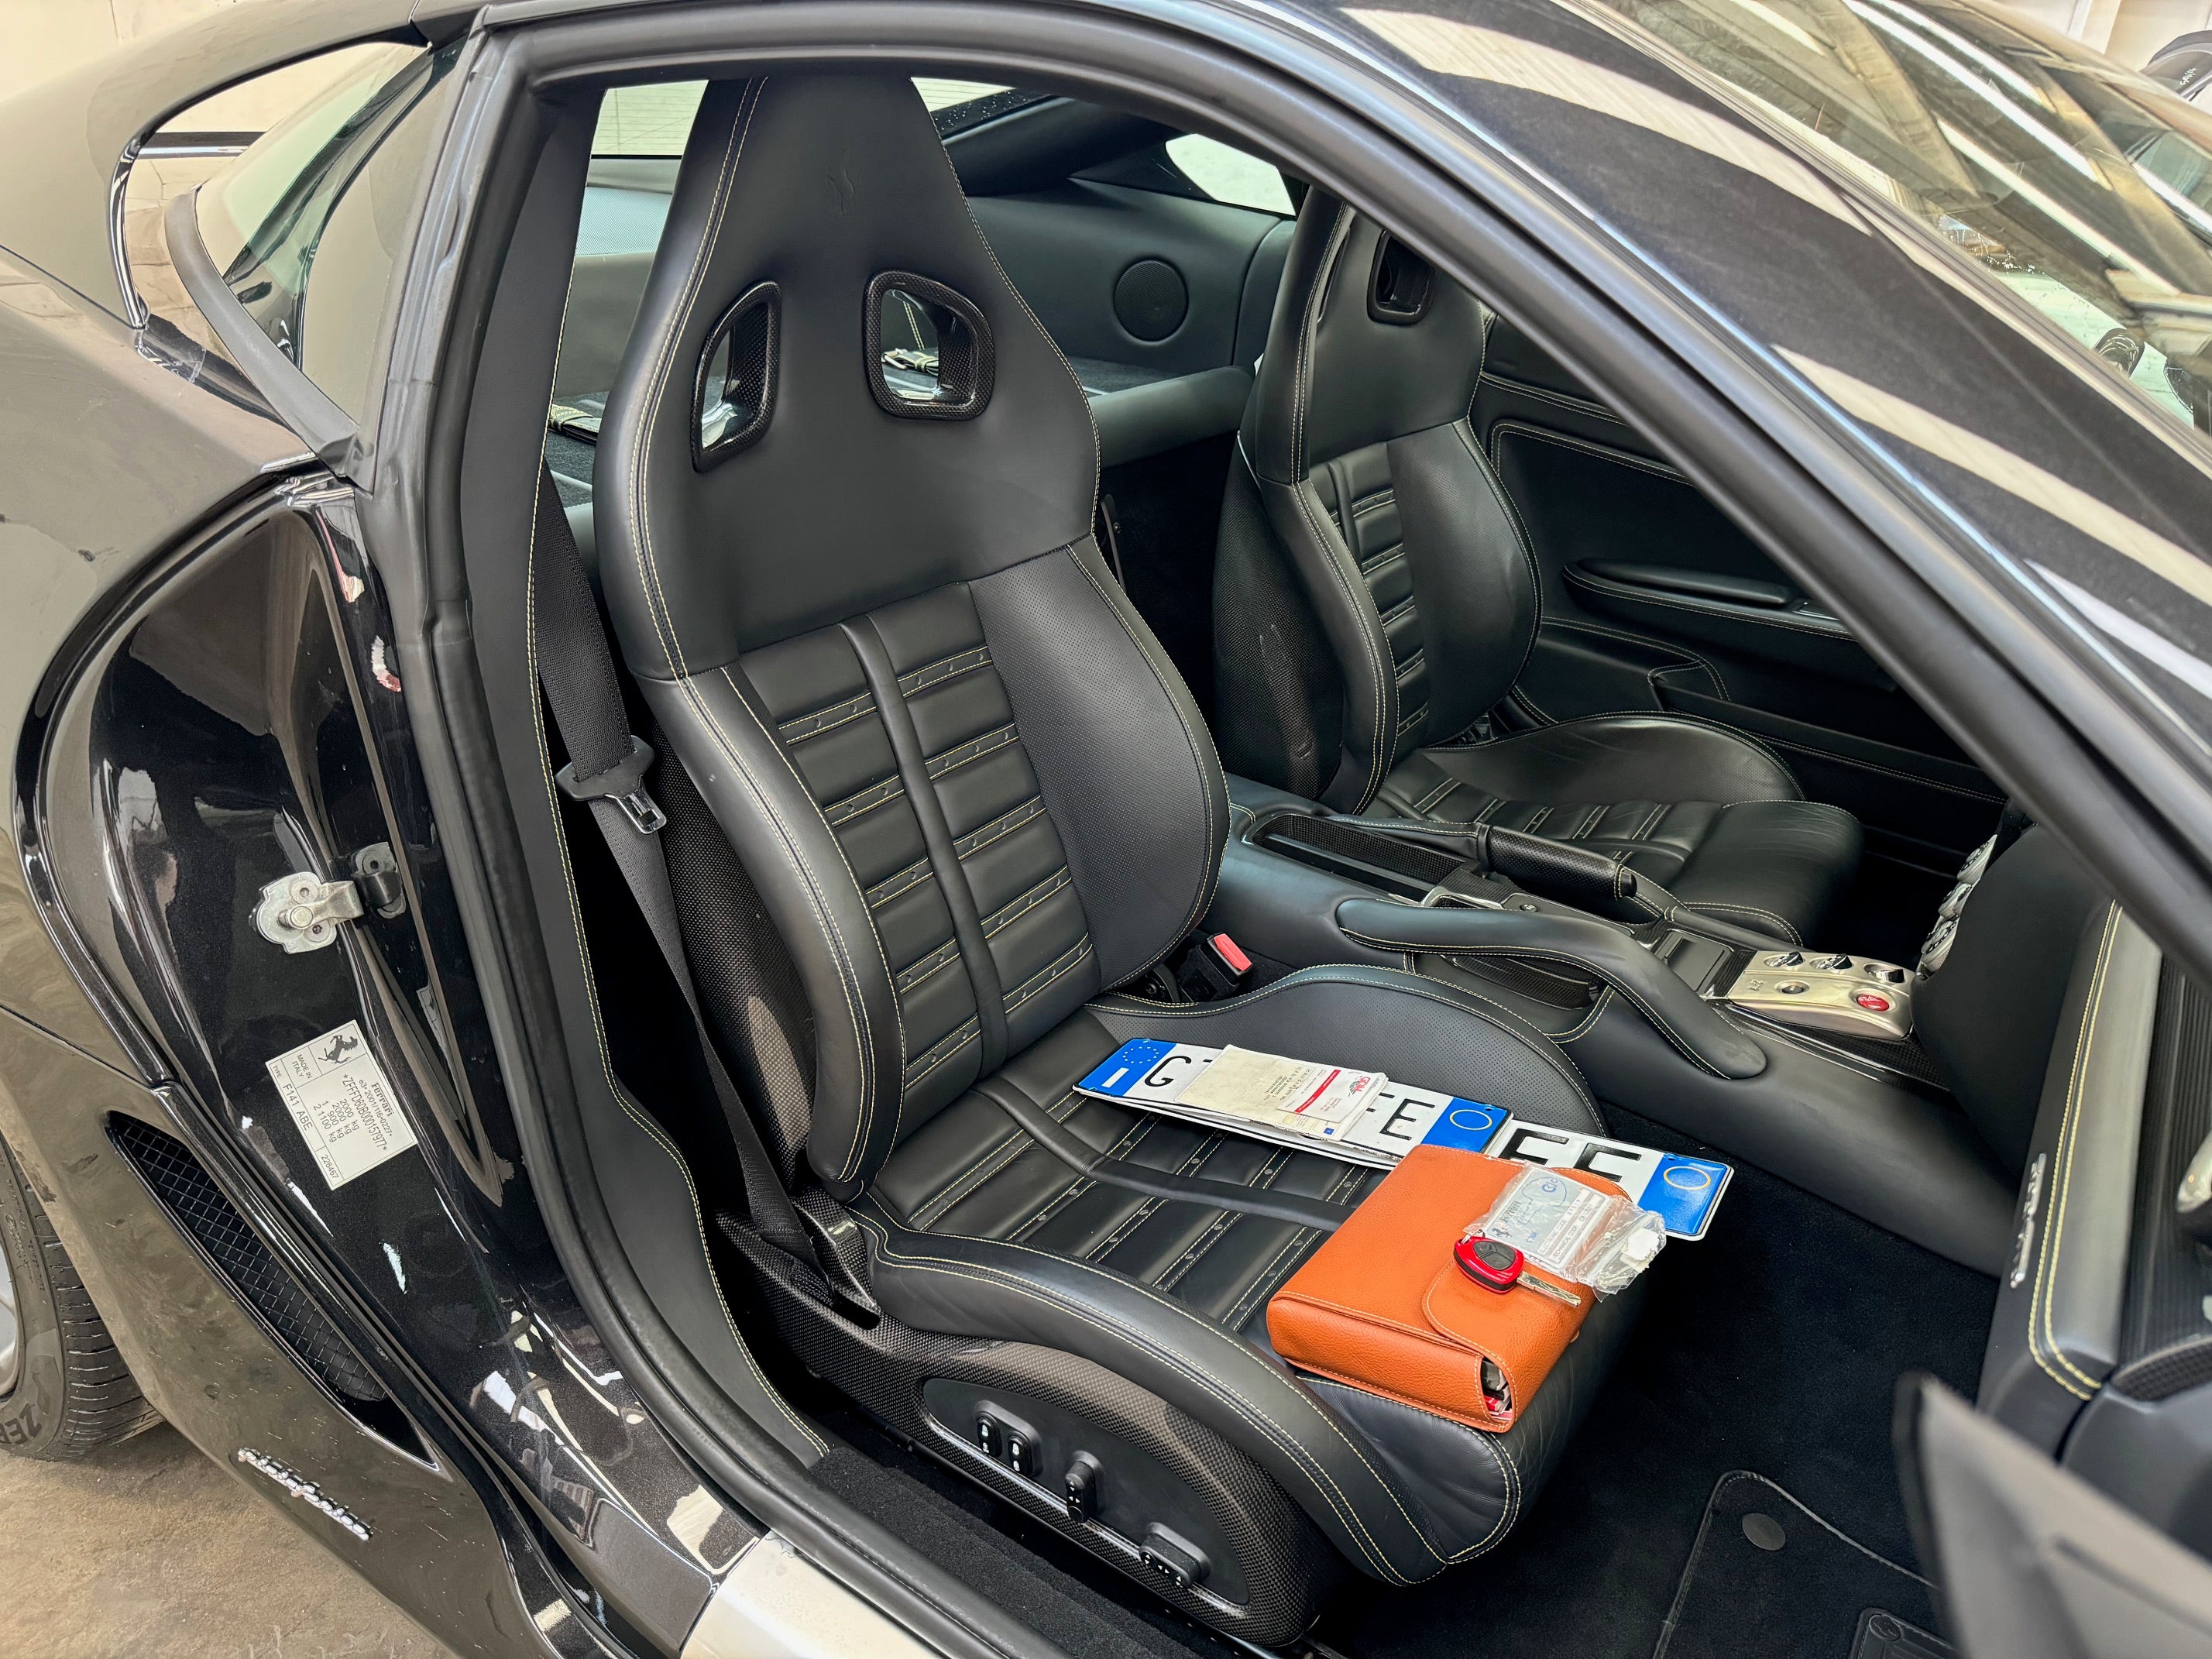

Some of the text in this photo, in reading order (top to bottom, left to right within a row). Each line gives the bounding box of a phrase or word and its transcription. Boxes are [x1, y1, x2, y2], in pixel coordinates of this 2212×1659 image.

[272, 1065, 282, 1078] TYPE
[291, 1060, 304, 1078] ITALY
[296, 1053, 312, 1078] MADE IN
[282, 1084, 312, 1130] F141 ABE
[370, 1081, 394, 1117] Ferrari
[317, 1111, 331, 1130] 1100
[327, 1132, 338, 1142] kg
[327, 1111, 338, 1126] 900
[334, 1128, 345, 1139] kg
[331, 1102, 352, 1135] 2000 kg
[338, 1098, 359, 1131] 2000 kg
[321, 1154, 338, 1180] 228467
